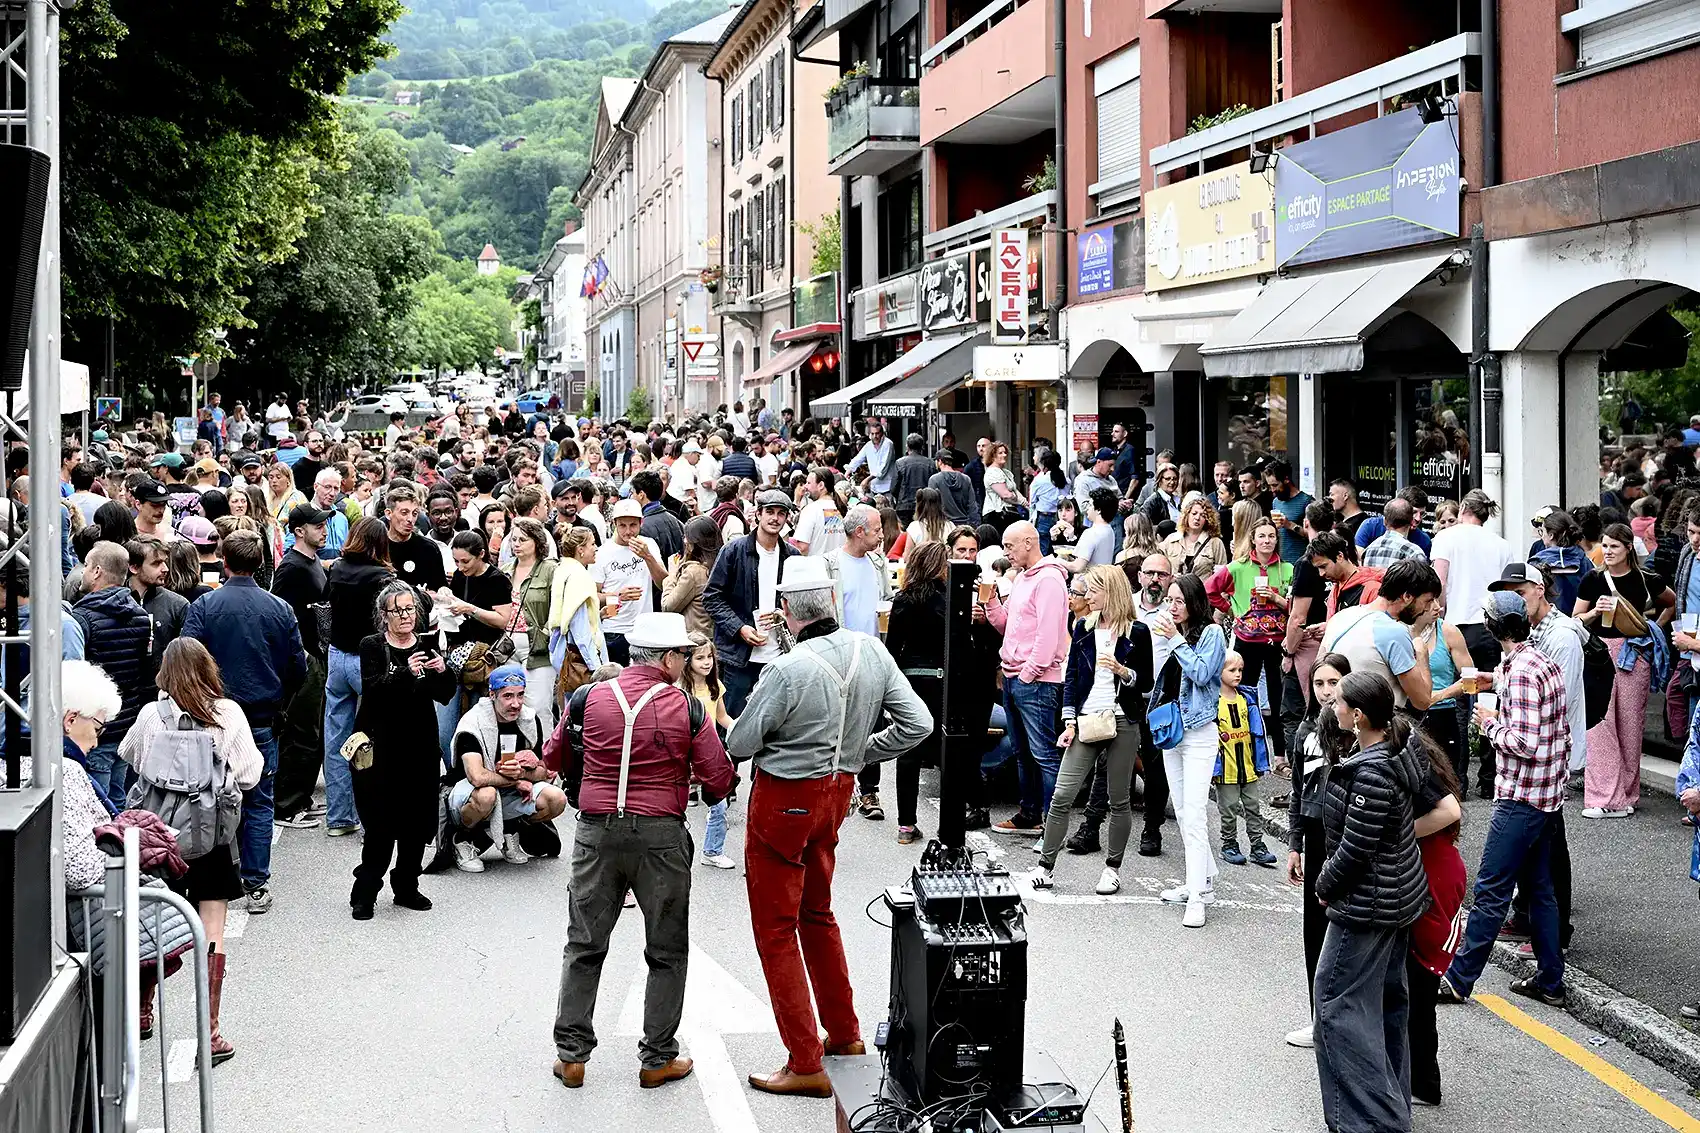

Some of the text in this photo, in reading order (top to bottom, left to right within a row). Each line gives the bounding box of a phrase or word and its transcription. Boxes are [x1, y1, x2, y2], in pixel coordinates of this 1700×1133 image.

[1396, 157, 1456, 189] HYPERION
[1287, 192, 1322, 220] efficity
[1327, 195, 1355, 214] ESPACE
[1000, 232, 1021, 322] LAVERIE
[984, 367, 1018, 377] CARE
[1358, 466, 1395, 481] WELCOME
[1422, 457, 1456, 481] efficity
